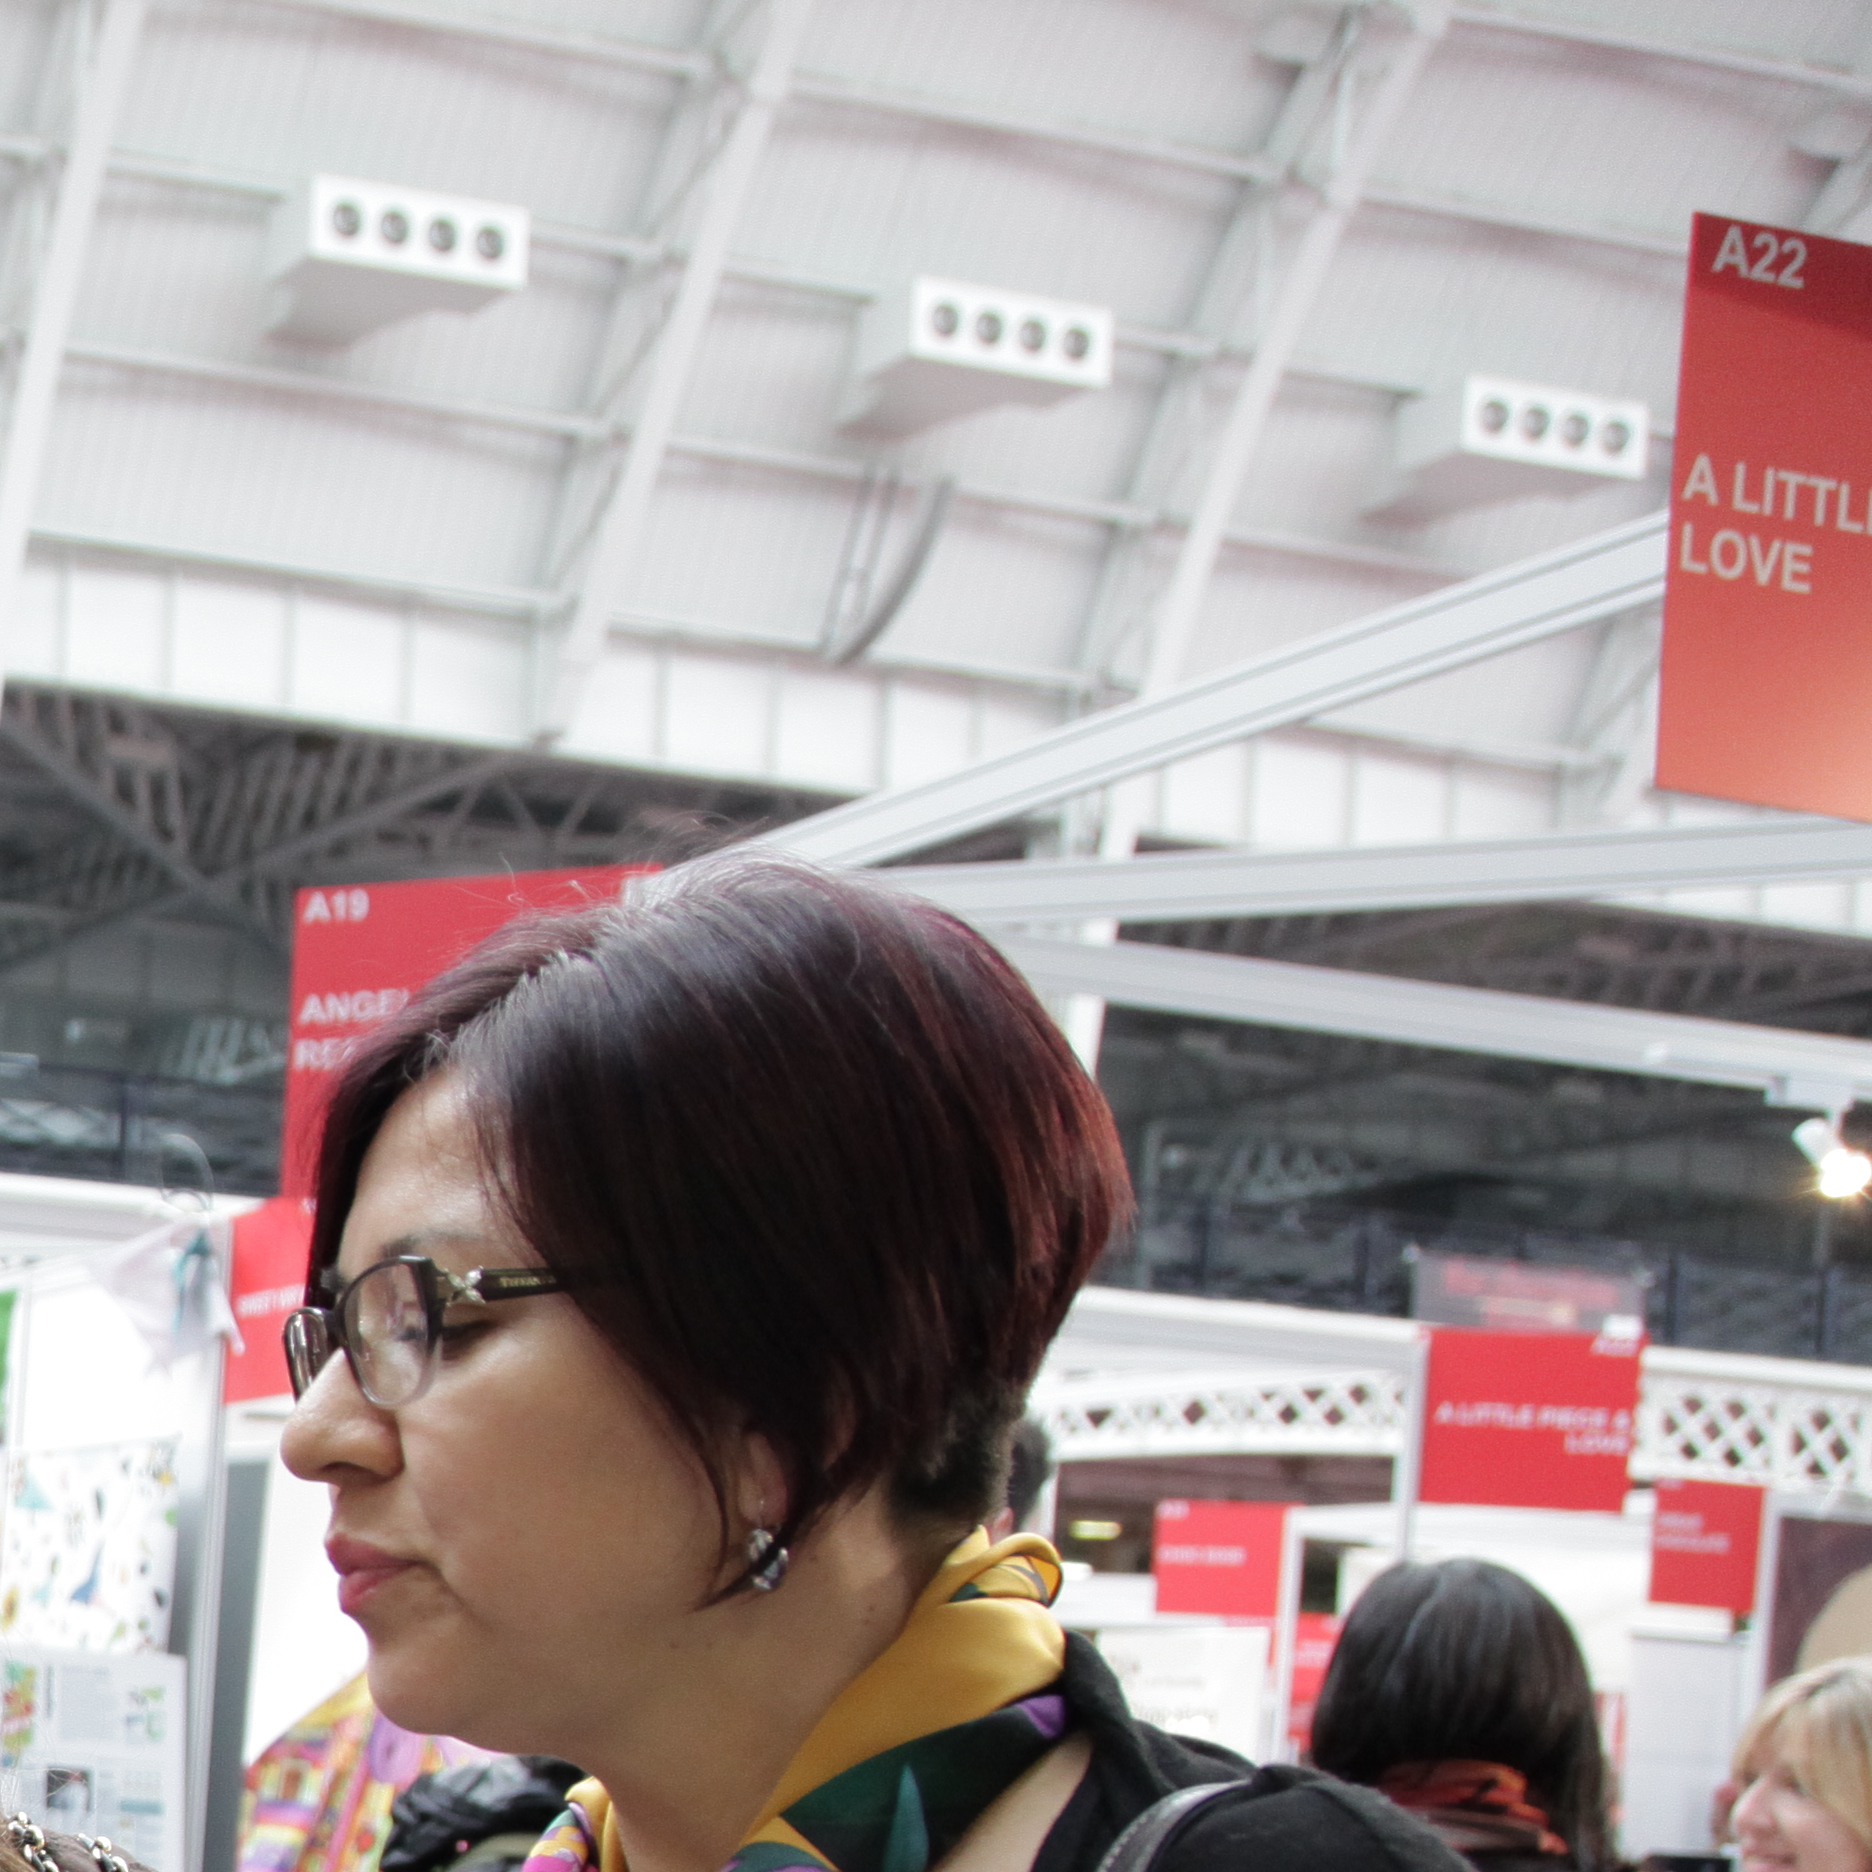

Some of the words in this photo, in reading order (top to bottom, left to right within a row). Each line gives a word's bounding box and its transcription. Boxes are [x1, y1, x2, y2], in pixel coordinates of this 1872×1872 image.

[1711, 225, 1808, 290] A22
[1681, 452, 1718, 507] A
[1679, 522, 1813, 593] LOVE
[303, 889, 370, 924] A19
